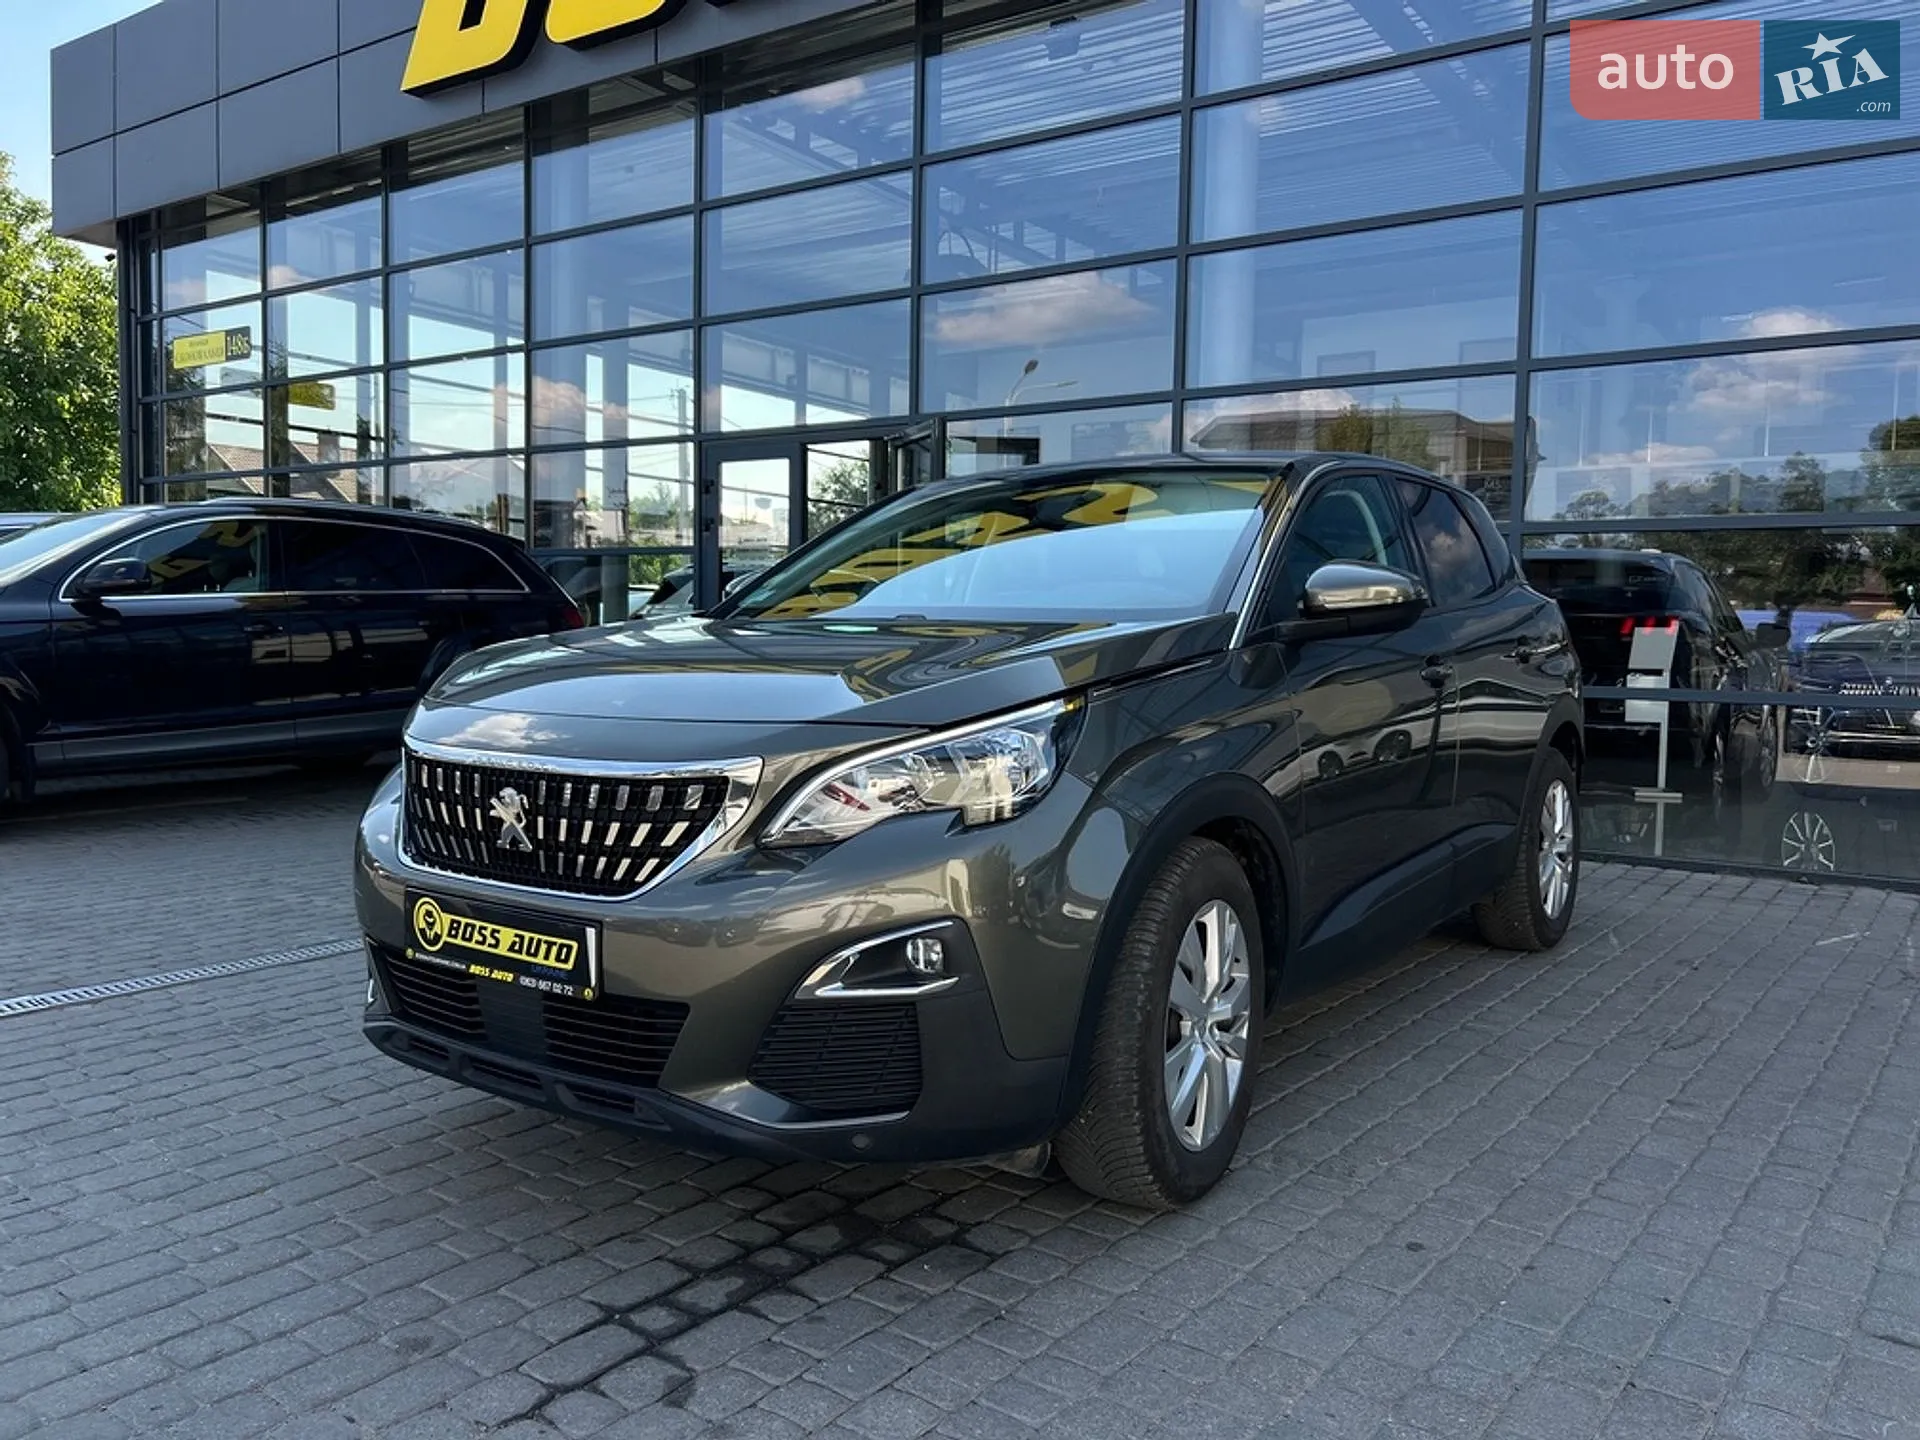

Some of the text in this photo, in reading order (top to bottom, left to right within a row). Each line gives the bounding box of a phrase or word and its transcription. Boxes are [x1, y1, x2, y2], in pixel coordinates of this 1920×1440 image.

[447, 919, 574, 963] BOSS AUTO
[469, 964, 514, 982] BOSS AUTO
